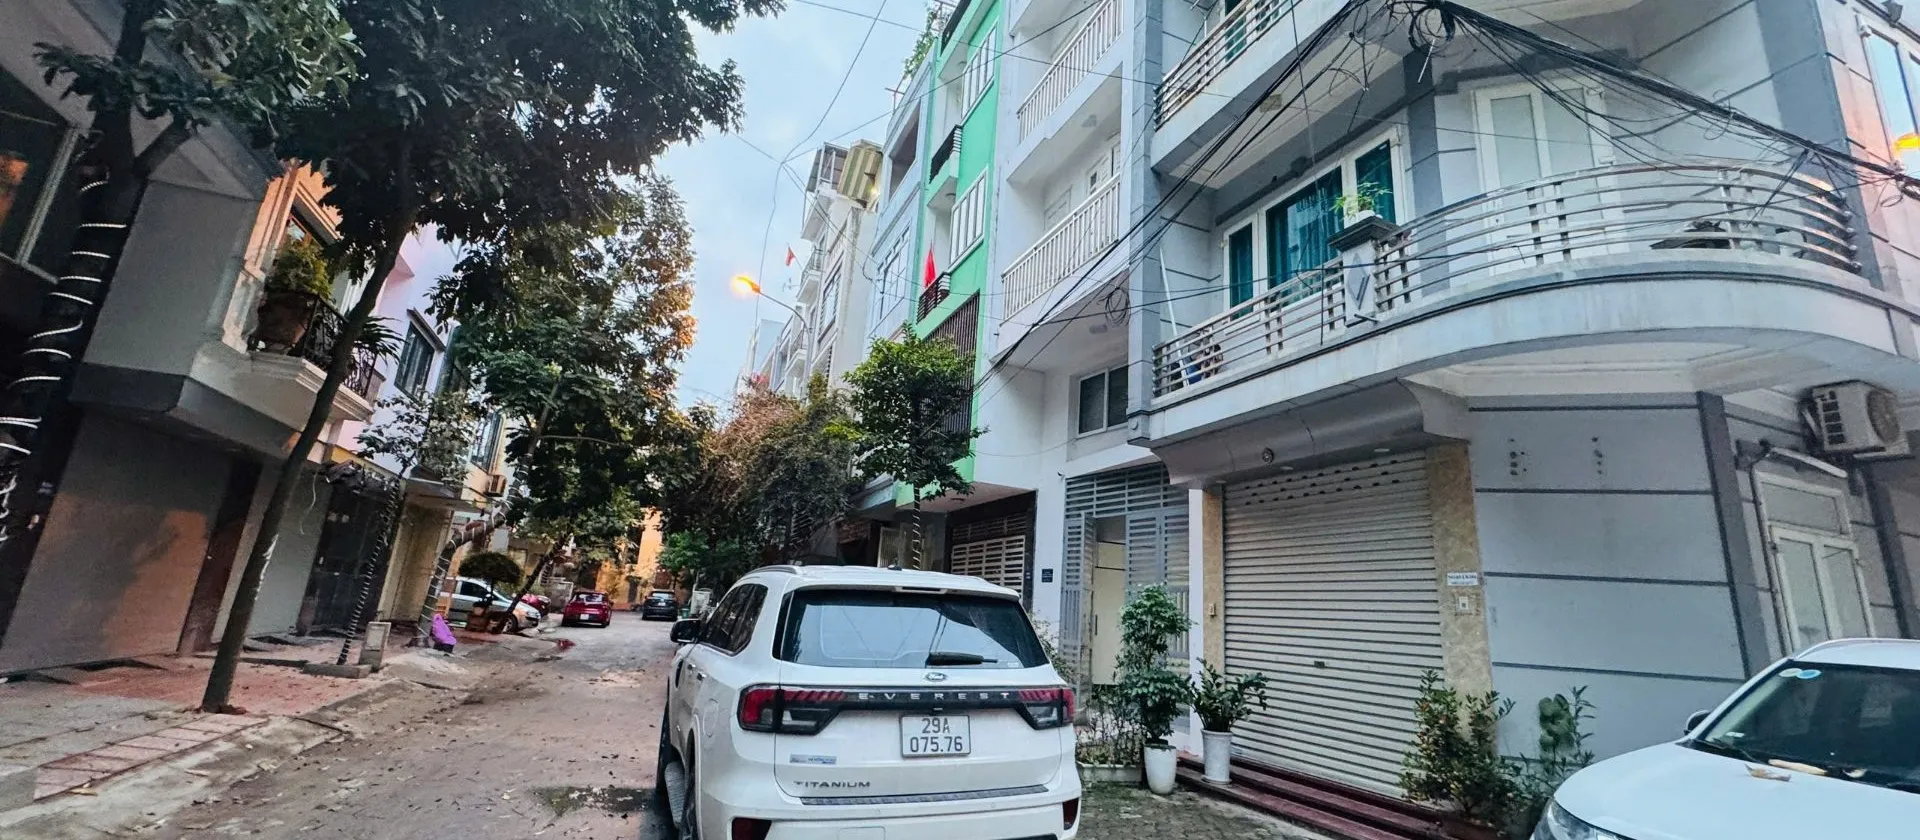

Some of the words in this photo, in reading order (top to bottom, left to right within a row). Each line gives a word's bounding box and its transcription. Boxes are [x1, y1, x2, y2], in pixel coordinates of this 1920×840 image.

[858, 692, 1010, 700] EVEREST
[921, 717, 950, 734] 29A
[909, 735, 963, 753] 075.76
